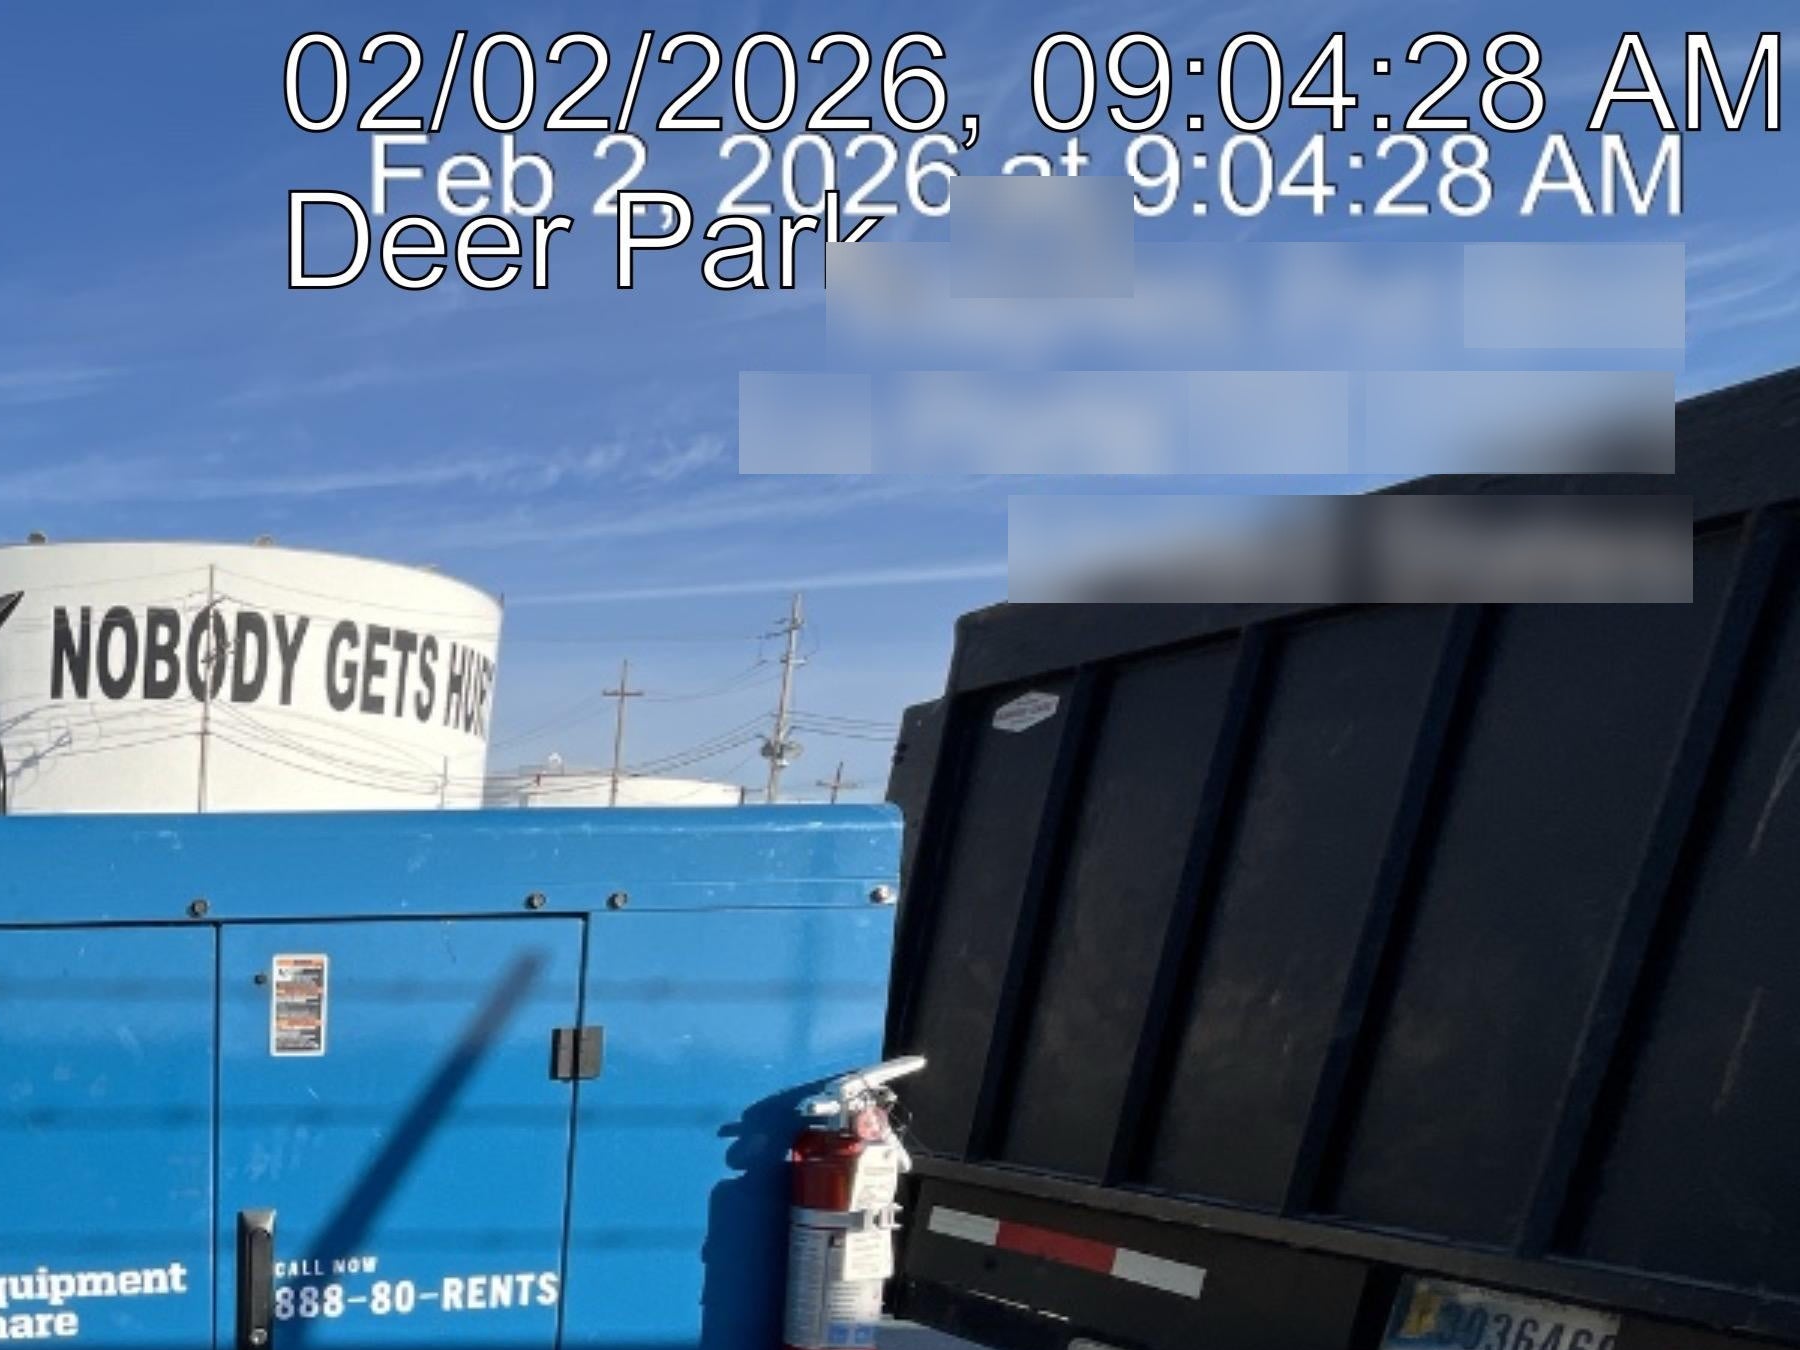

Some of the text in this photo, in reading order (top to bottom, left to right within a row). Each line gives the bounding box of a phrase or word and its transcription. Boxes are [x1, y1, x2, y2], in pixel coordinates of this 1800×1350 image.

[50, 604, 310, 706] NOBODY
[325, 620, 439, 723] GETS
[274, 1256, 379, 1278] CALL NOW
[274, 1271, 560, 1321] 888-80-RENTS
